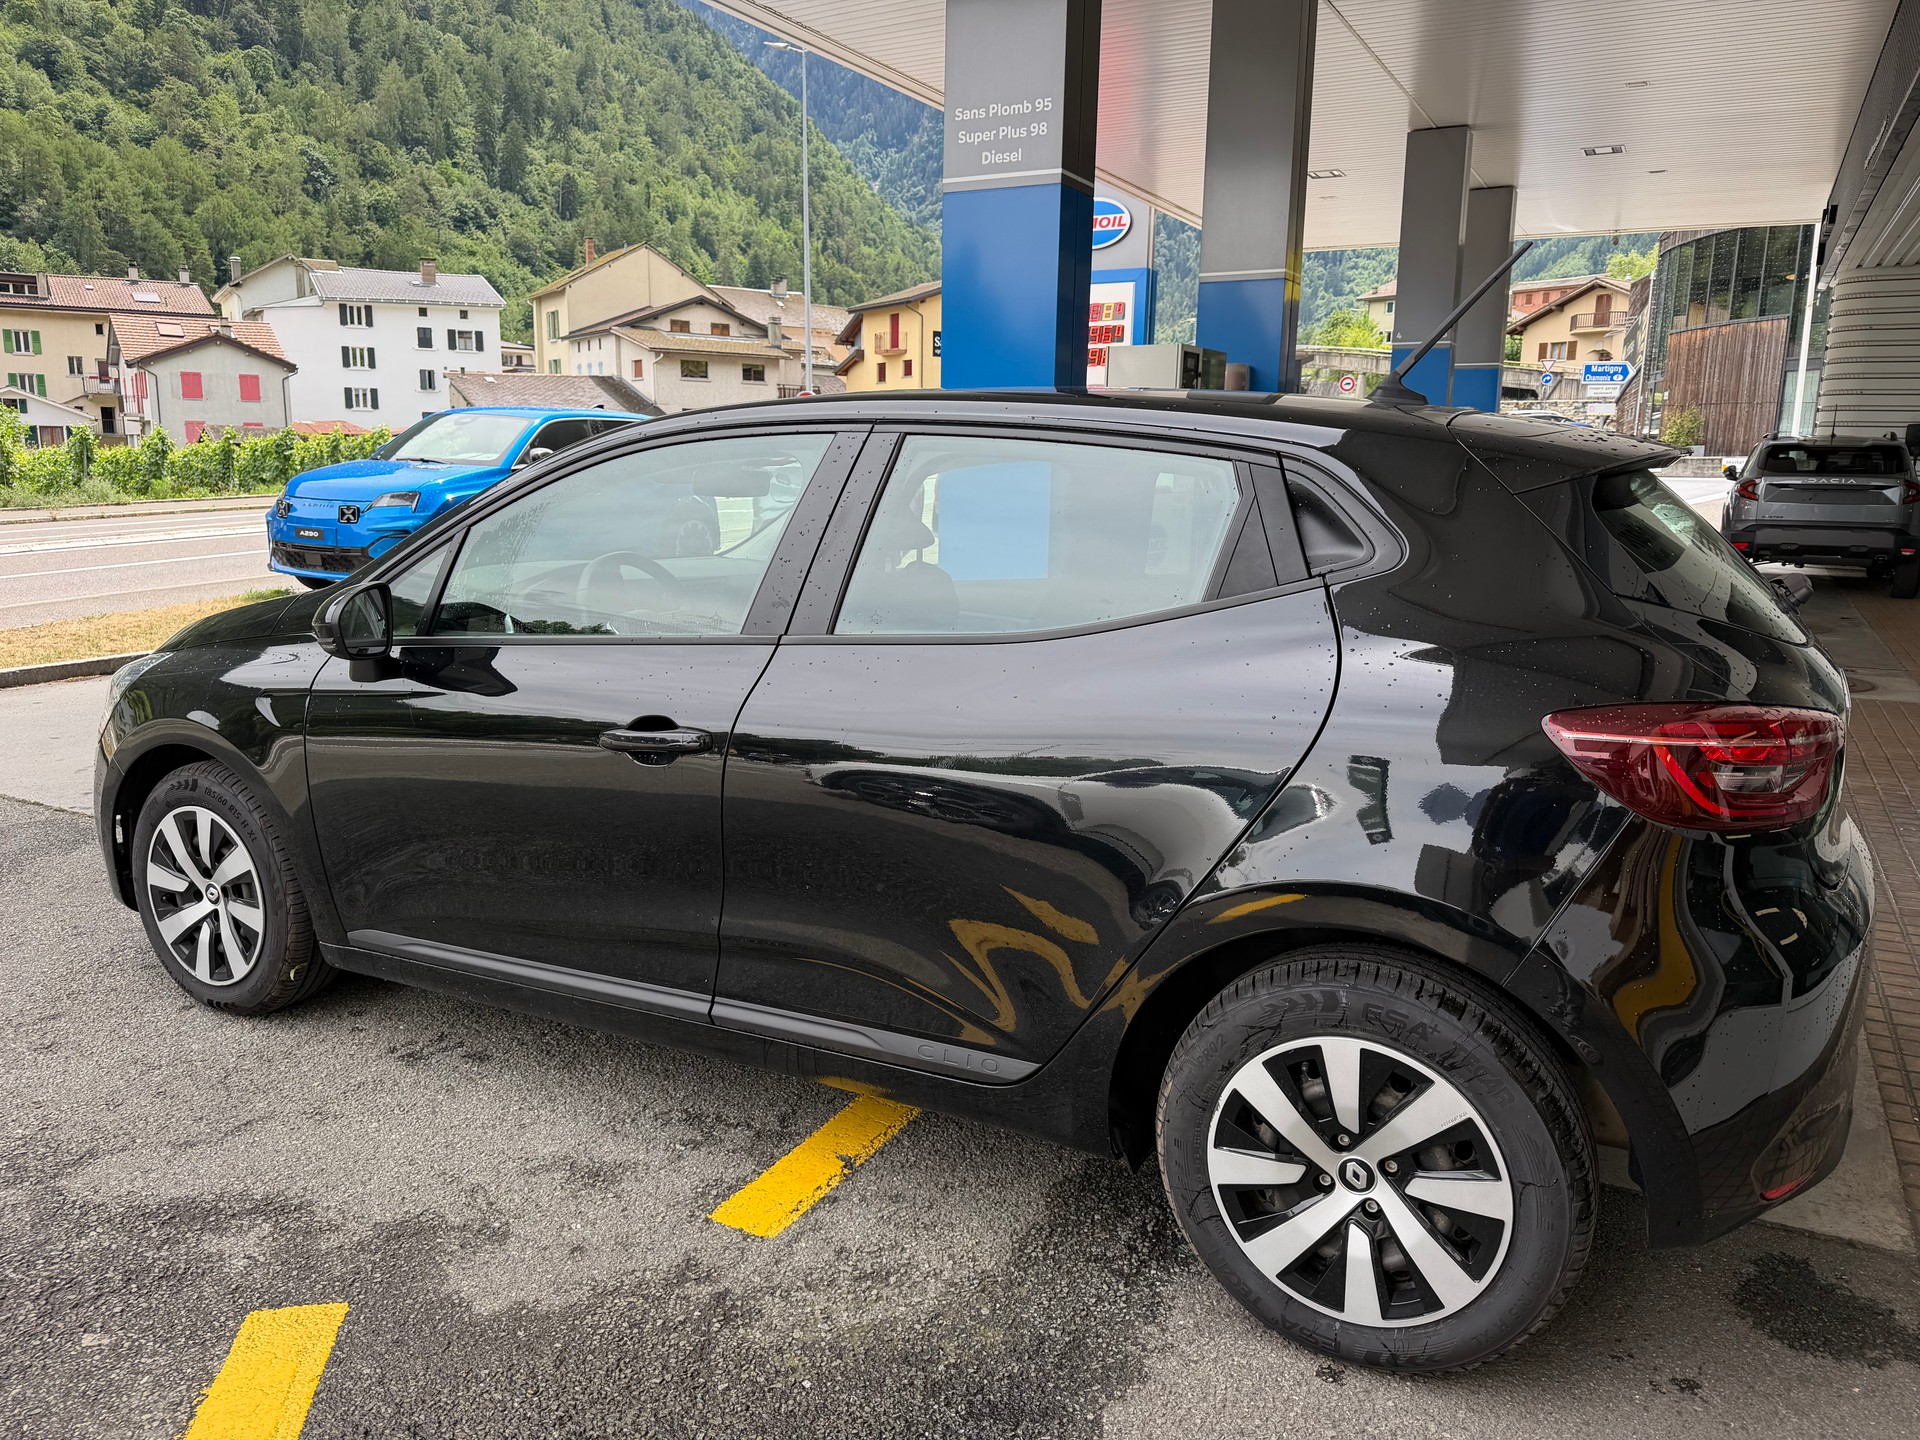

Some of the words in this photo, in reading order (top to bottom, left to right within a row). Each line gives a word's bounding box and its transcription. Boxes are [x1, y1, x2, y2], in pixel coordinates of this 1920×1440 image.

[955, 107, 986, 121] Sans
[989, 100, 1032, 117] Plomb
[1035, 97, 1052, 112] 95
[958, 130, 996, 145] Super
[999, 125, 1027, 139] Plus
[1030, 122, 1047, 136] 98
[982, 148, 1022, 164] Diesel
[1591, 365, 1622, 374] Martigny
[917, 1044, 1001, 1074] CLIO
